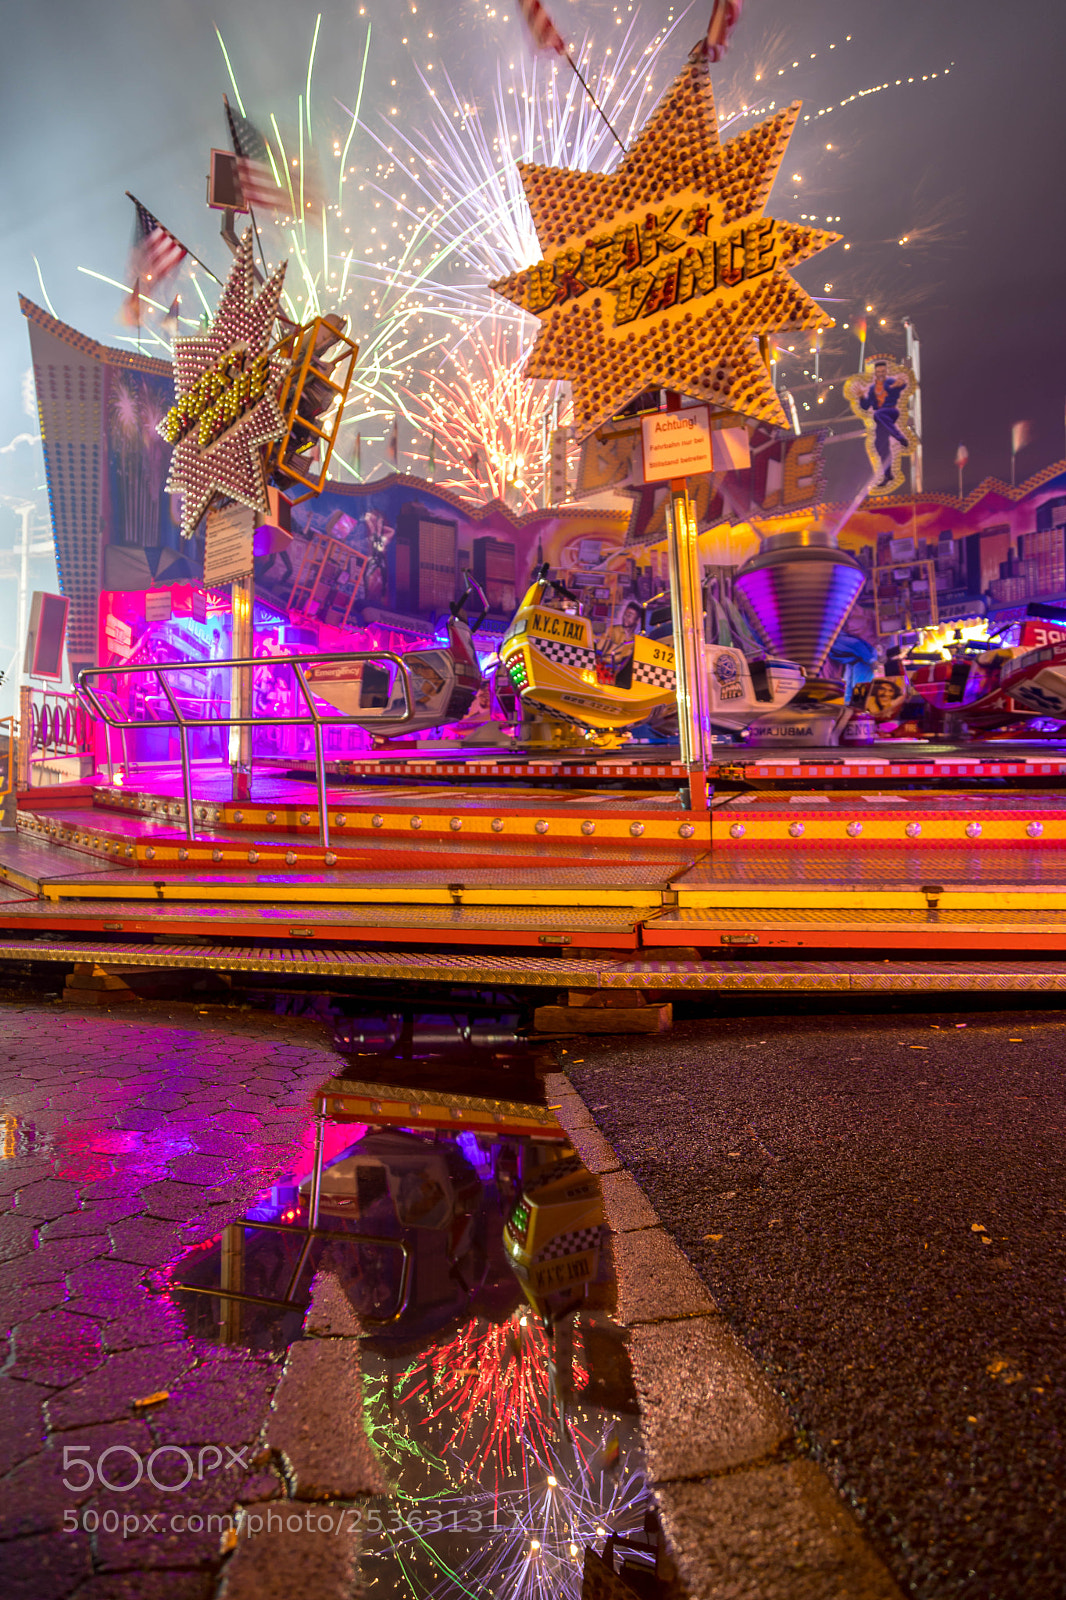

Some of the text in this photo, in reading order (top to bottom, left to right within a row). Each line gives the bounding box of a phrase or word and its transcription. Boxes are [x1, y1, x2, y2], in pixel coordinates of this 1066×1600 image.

[527, 208, 687, 315] BREAK
[606, 217, 777, 326] DANCE
[655, 415, 697, 433] Achtung!
[649, 436, 704, 451] Fahrbahn nur bei
[532, 613, 560, 636] N.Y.C.
[562, 620, 584, 641] TAXI
